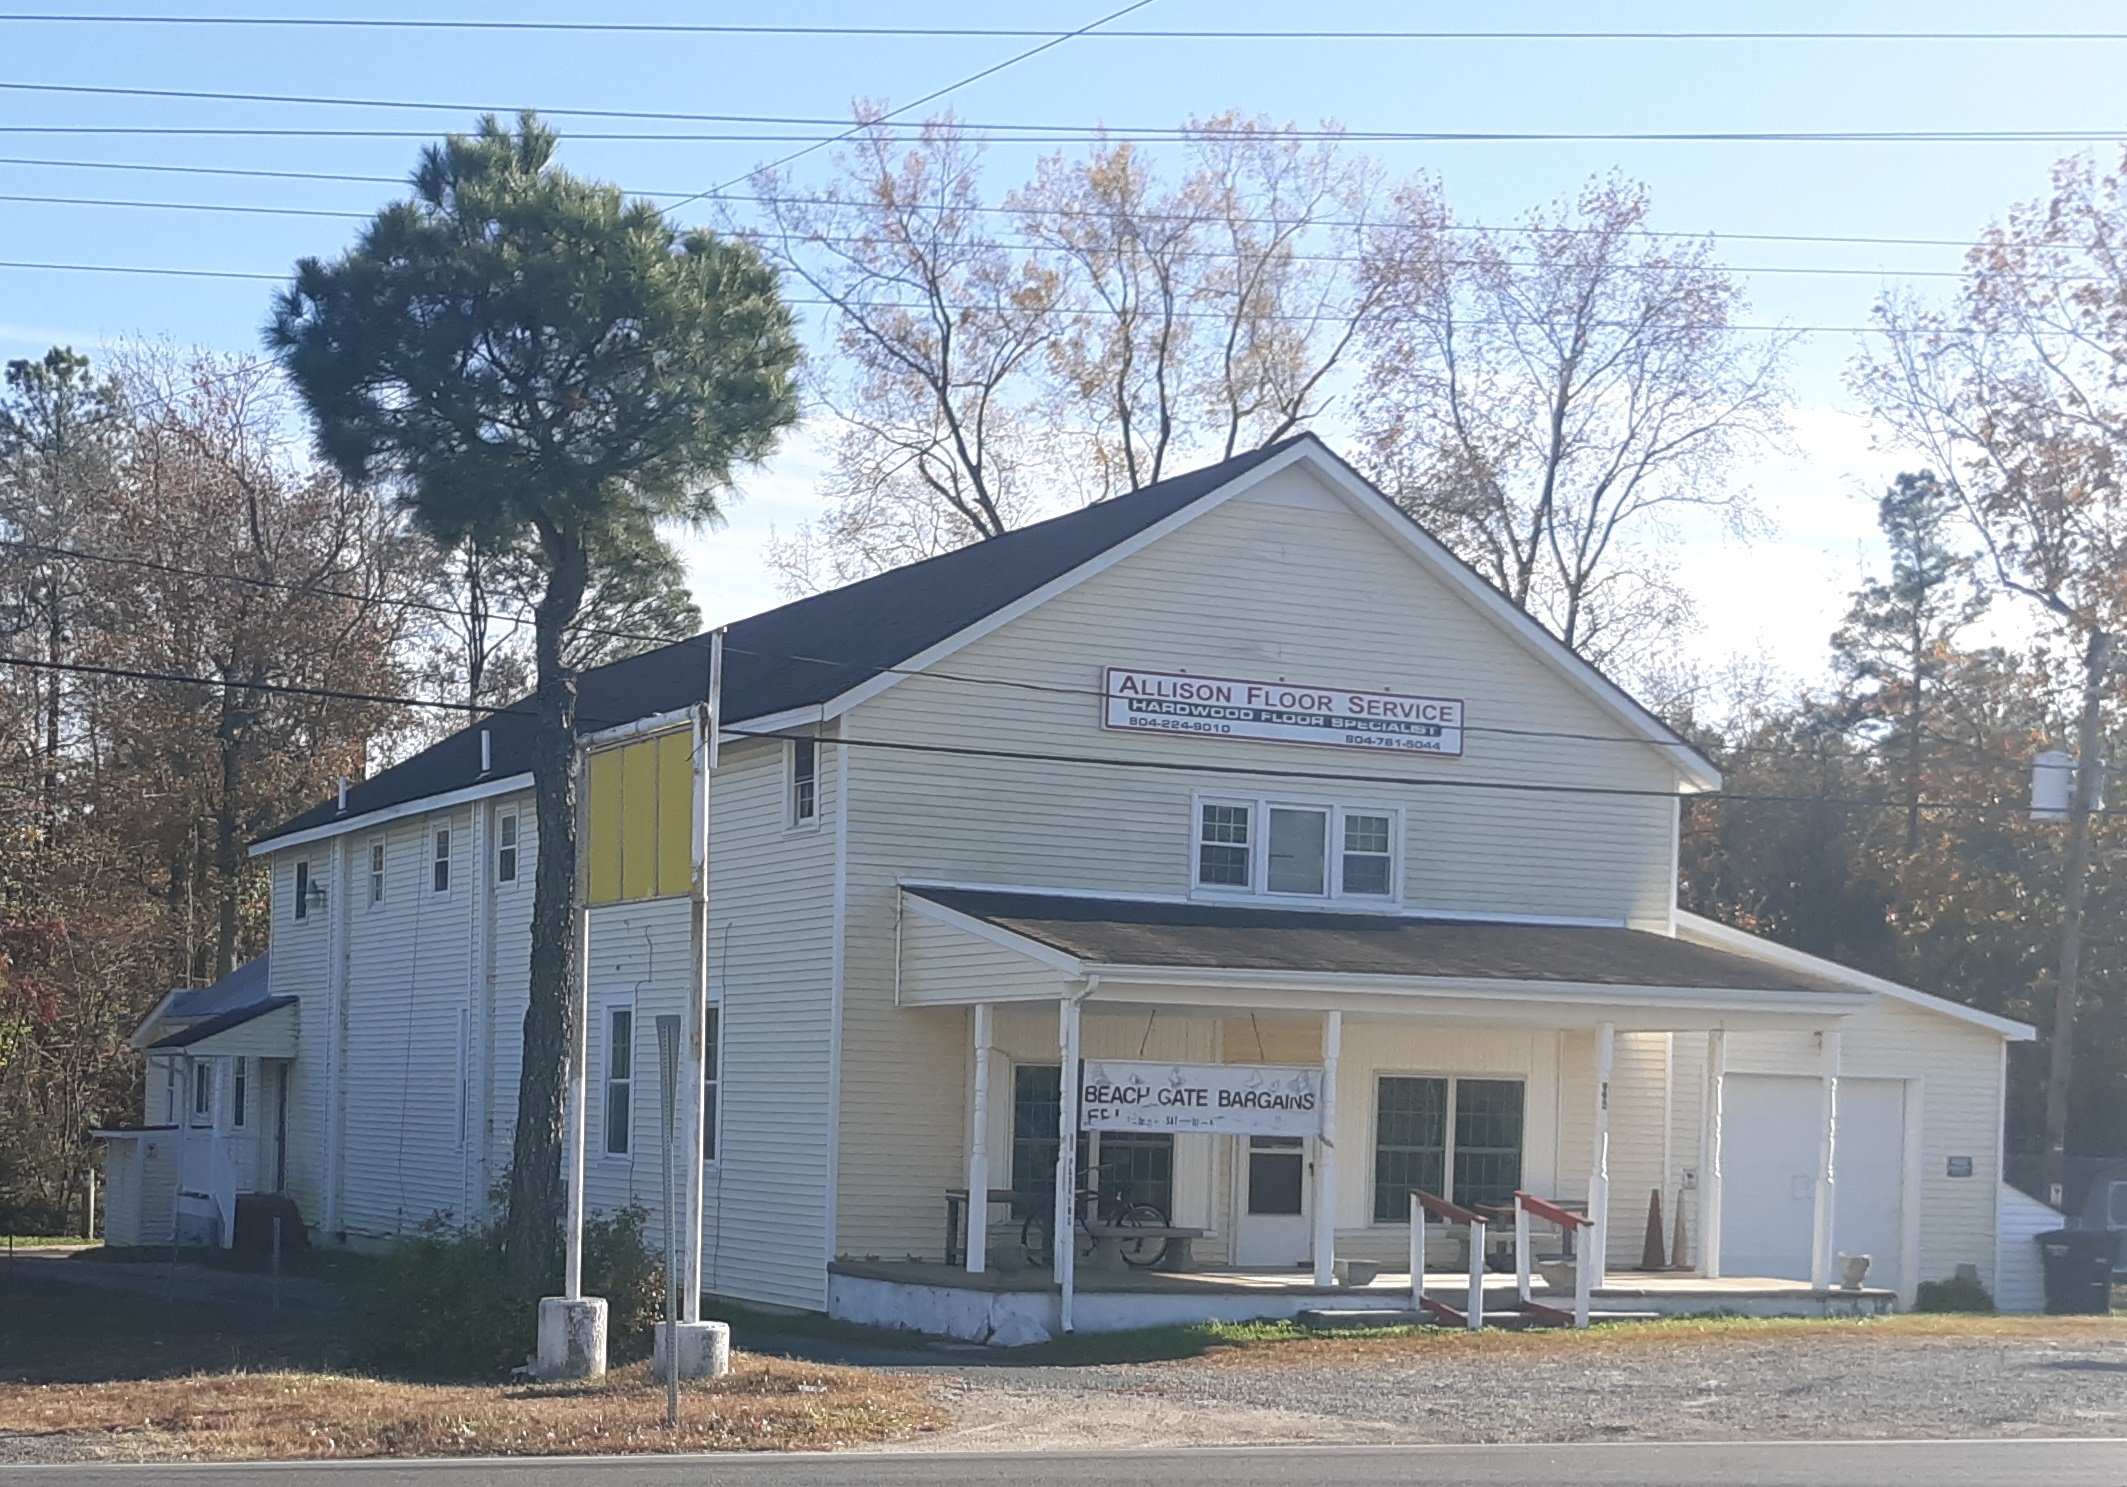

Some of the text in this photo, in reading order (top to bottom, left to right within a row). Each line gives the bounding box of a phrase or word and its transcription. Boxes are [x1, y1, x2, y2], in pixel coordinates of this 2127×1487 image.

[1118, 675, 1454, 723] ALLISON FLOOR SERVICE
[1128, 716, 1231, 733] 804-224-9010
[1133, 699, 1438, 736] HARDWOOD FLOOR SPECIALIST
[1157, 1088, 1209, 1107] GATE
[1218, 1090, 1315, 1111] BARGAINS
